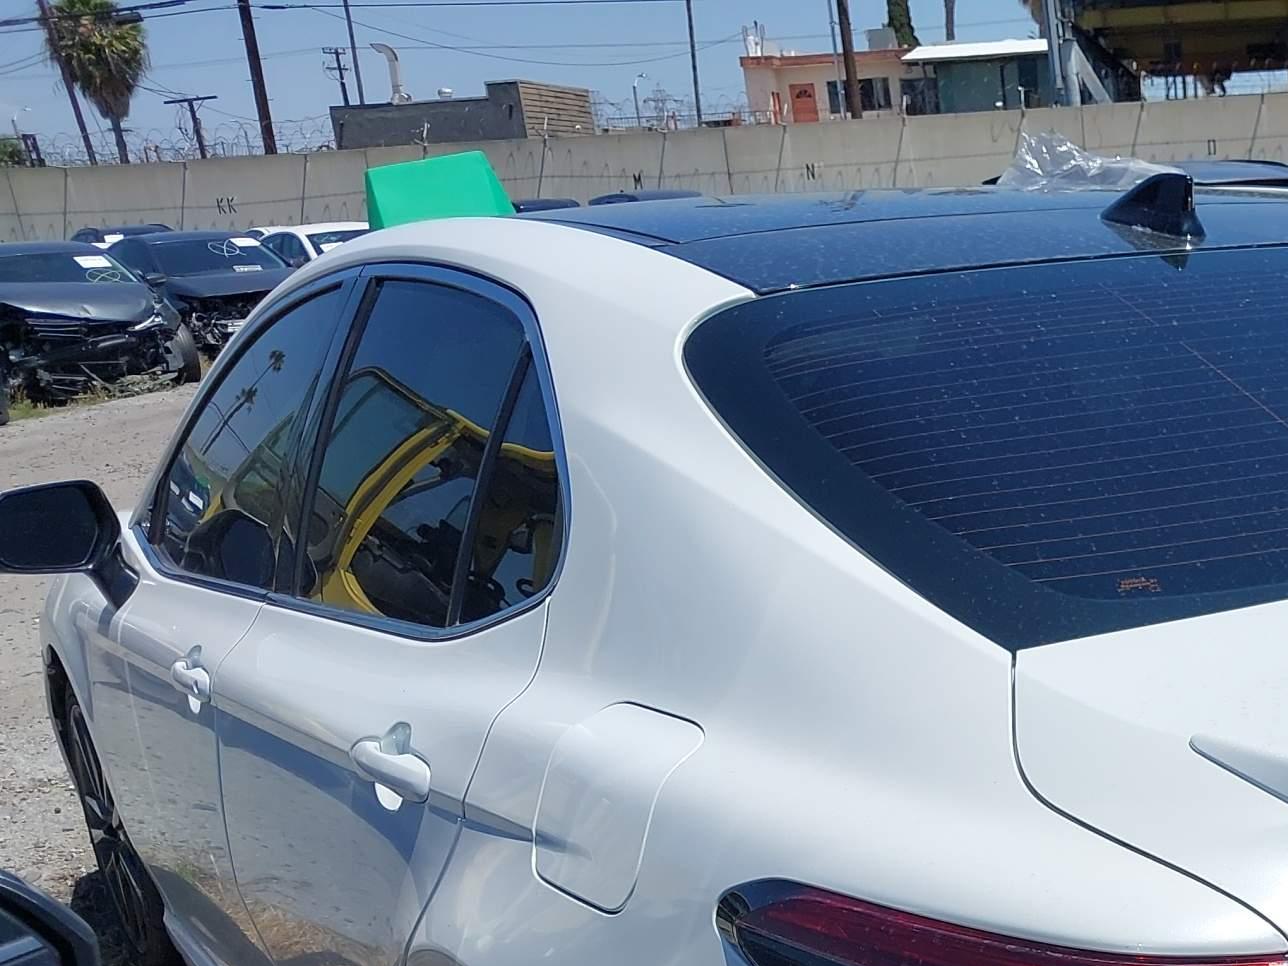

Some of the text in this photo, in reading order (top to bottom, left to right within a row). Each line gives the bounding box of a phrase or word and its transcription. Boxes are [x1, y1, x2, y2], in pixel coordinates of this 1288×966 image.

[805, 162, 816, 181] N
[632, 172, 644, 191] M
[216, 196, 238, 215] KK
